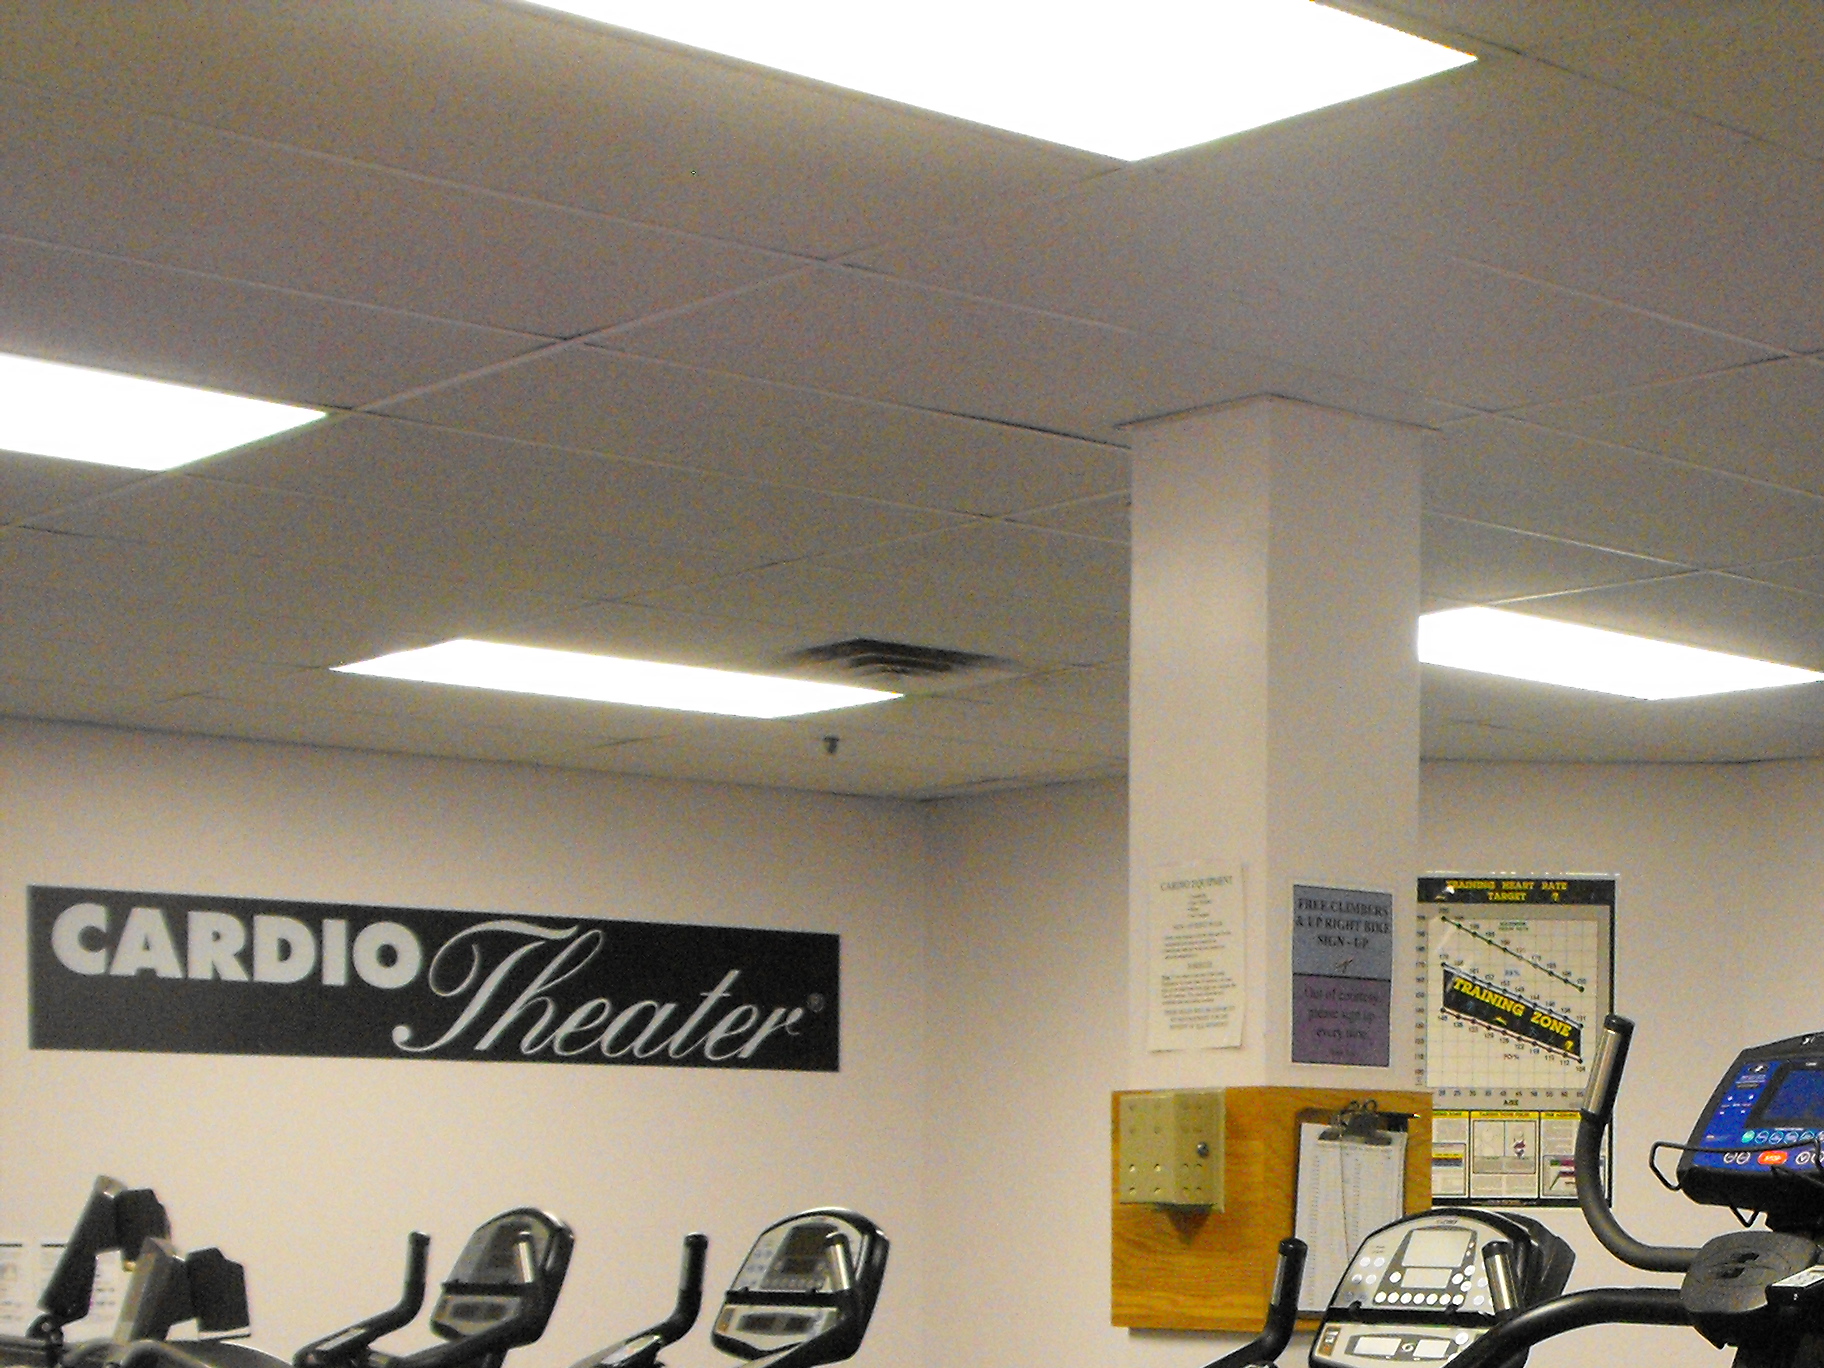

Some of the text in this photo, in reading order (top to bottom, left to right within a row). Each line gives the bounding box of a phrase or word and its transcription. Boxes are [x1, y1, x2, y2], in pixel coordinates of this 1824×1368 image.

[1446, 880, 1569, 891] TRAINING HEART RATE
[1487, 891, 1528, 901] TARGET
[1299, 898, 1326, 912] FREE
[1364, 921, 1391, 934] BIKE
[1316, 935, 1345, 948] SIGN
[51, 902, 804, 1061] CARDIO Theater
[1453, 977, 1526, 1017] TRAINING
[1529, 1011, 1573, 1038] ZONE
